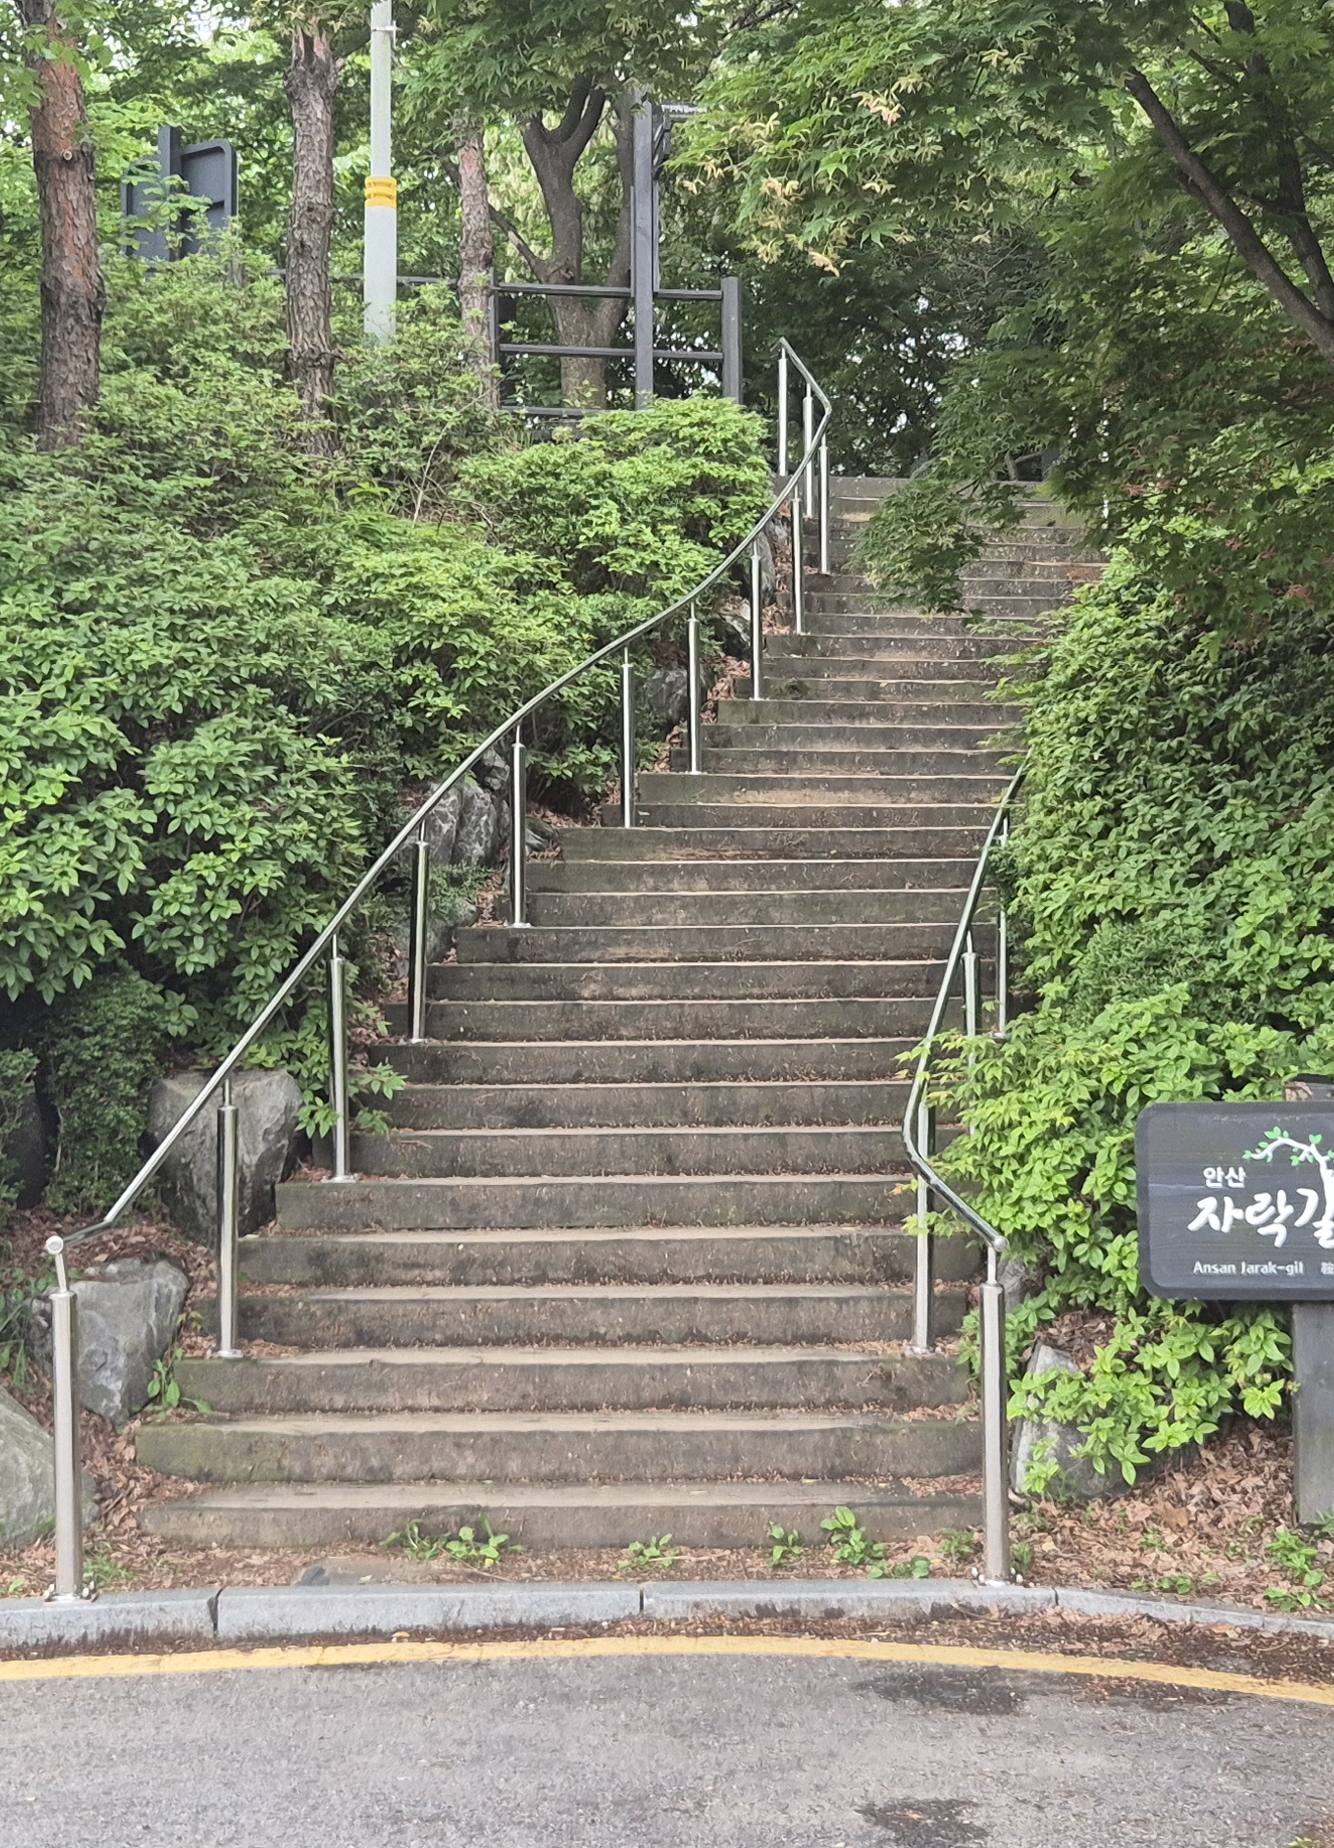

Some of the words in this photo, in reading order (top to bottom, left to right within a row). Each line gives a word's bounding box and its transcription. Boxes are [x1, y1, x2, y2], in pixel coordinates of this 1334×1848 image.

[1203, 1167, 1246, 1188] 안산
[1193, 1261, 1237, 1275] Ansan
[1241, 1261, 1304, 1277] Jarak-gil
